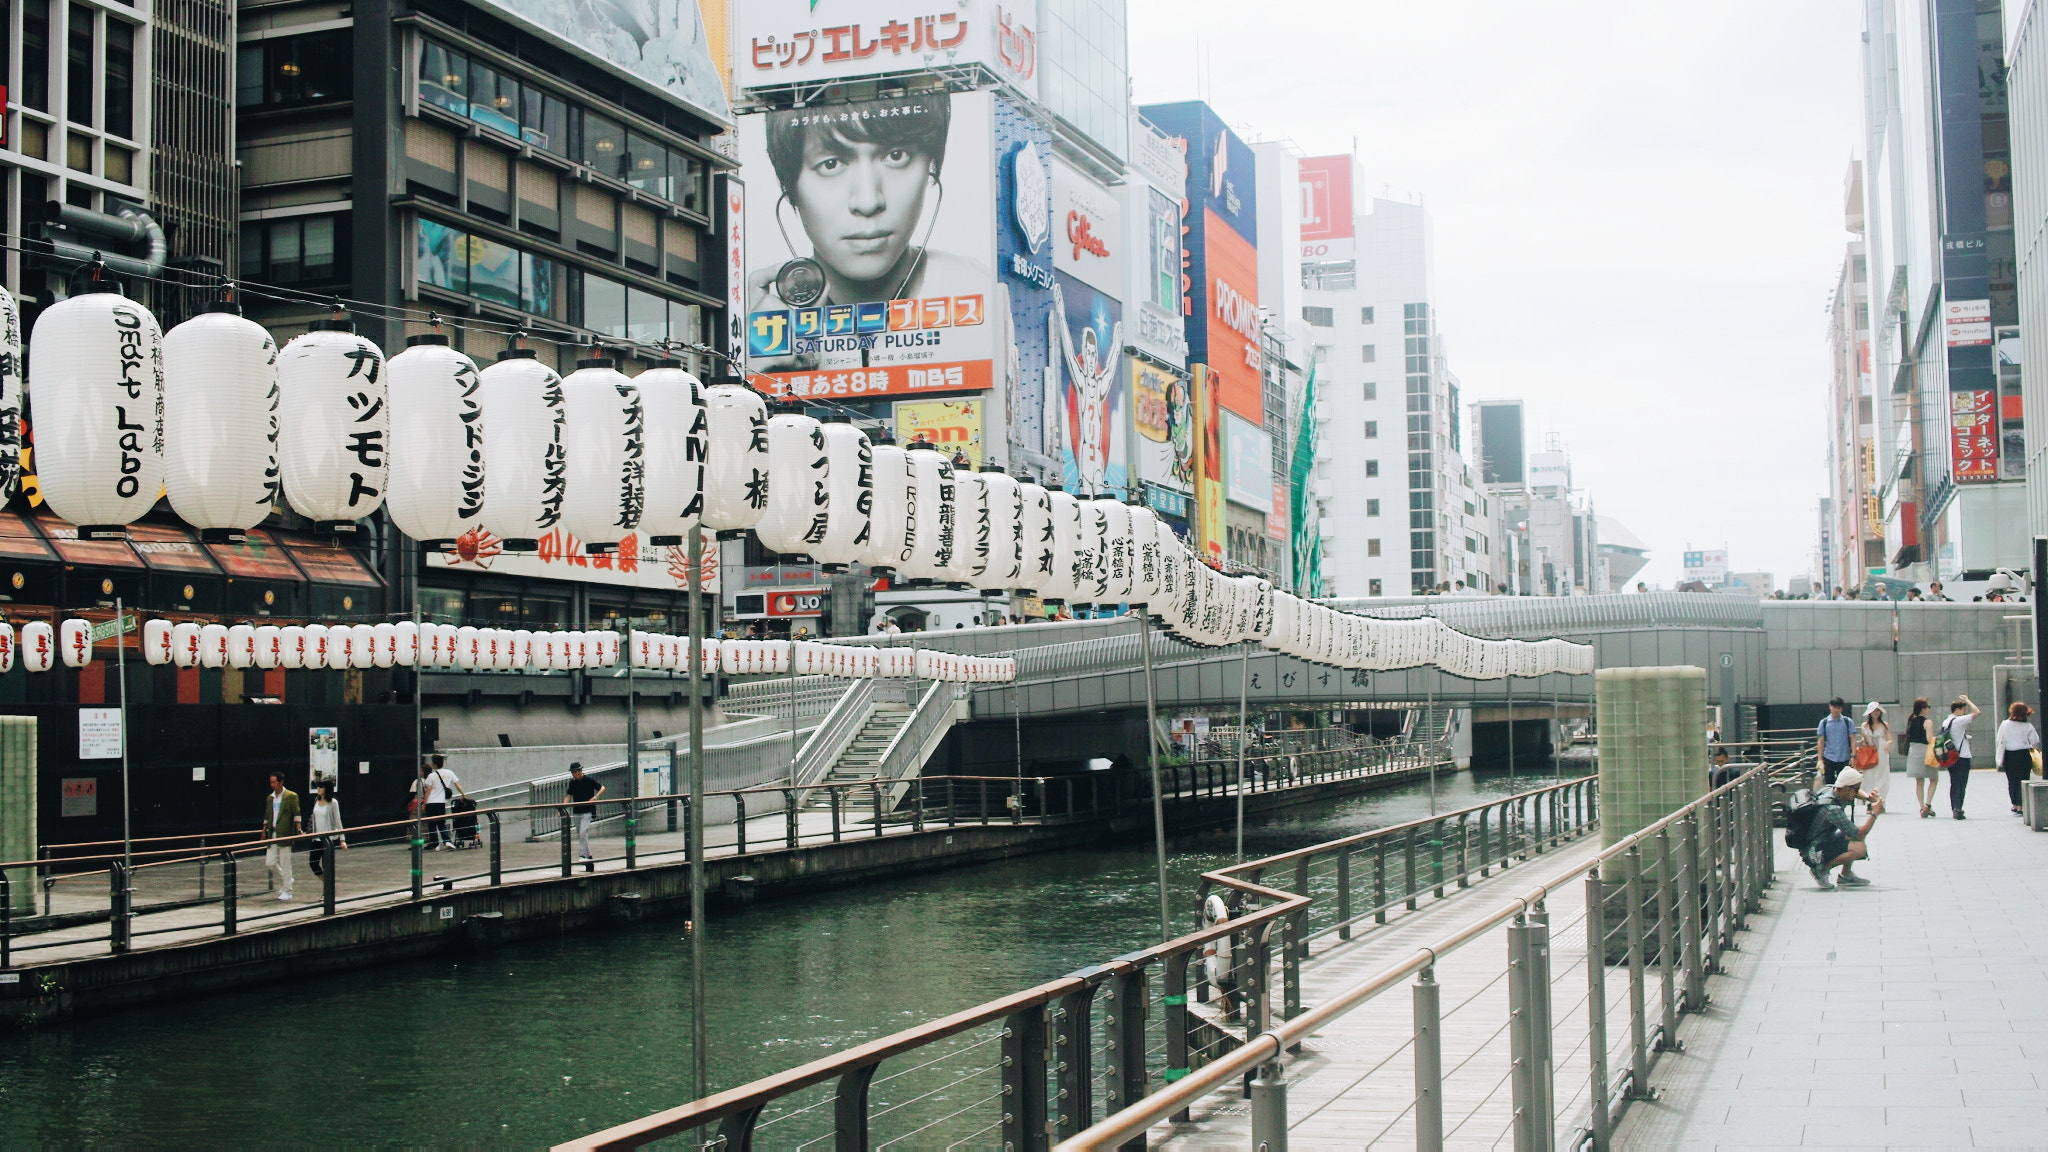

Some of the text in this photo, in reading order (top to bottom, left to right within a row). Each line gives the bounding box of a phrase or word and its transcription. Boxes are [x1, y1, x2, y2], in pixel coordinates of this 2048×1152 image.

[752, 13, 968, 70] ピップエレキバン
[997, 4, 1037, 81] ピップ
[731, 221, 741, 304] 本場の味
[1014, 253, 1055, 290] 雪印メグミルク
[1946, 240, 1984, 250] 戎橋ビル
[752, 298, 977, 351] サタデープラス
[795, 332, 924, 355] SATURDAY PLUS
[112, 305, 145, 498] Smart Labo
[771, 371, 888, 397] 土曜あさ8時
[908, 367, 963, 388] MBS
[343, 343, 384, 507] カツモト
[535, 372, 567, 529] クチュールワカイケ
[680, 383, 709, 520] LAMIA
[912, 426, 968, 443] an
[1087, 403, 1096, 462] グリコ
[1957, 427, 1974, 471] コミック
[1975, 391, 1995, 470] インターネット
[743, 408, 769, 509] 岩橋
[802, 427, 830, 544] かつら屋
[854, 436, 874, 547] SEGA
[900, 452, 917, 562] EL RODEO
[1038, 491, 1056, 577] 小大丸
[1111, 536, 1125, 579] 心斎橋店
[1142, 541, 1154, 583] 心斎橋店
[1081, 547, 1095, 581] 心斎橋
[1250, 671, 1369, 689] えびす橋
